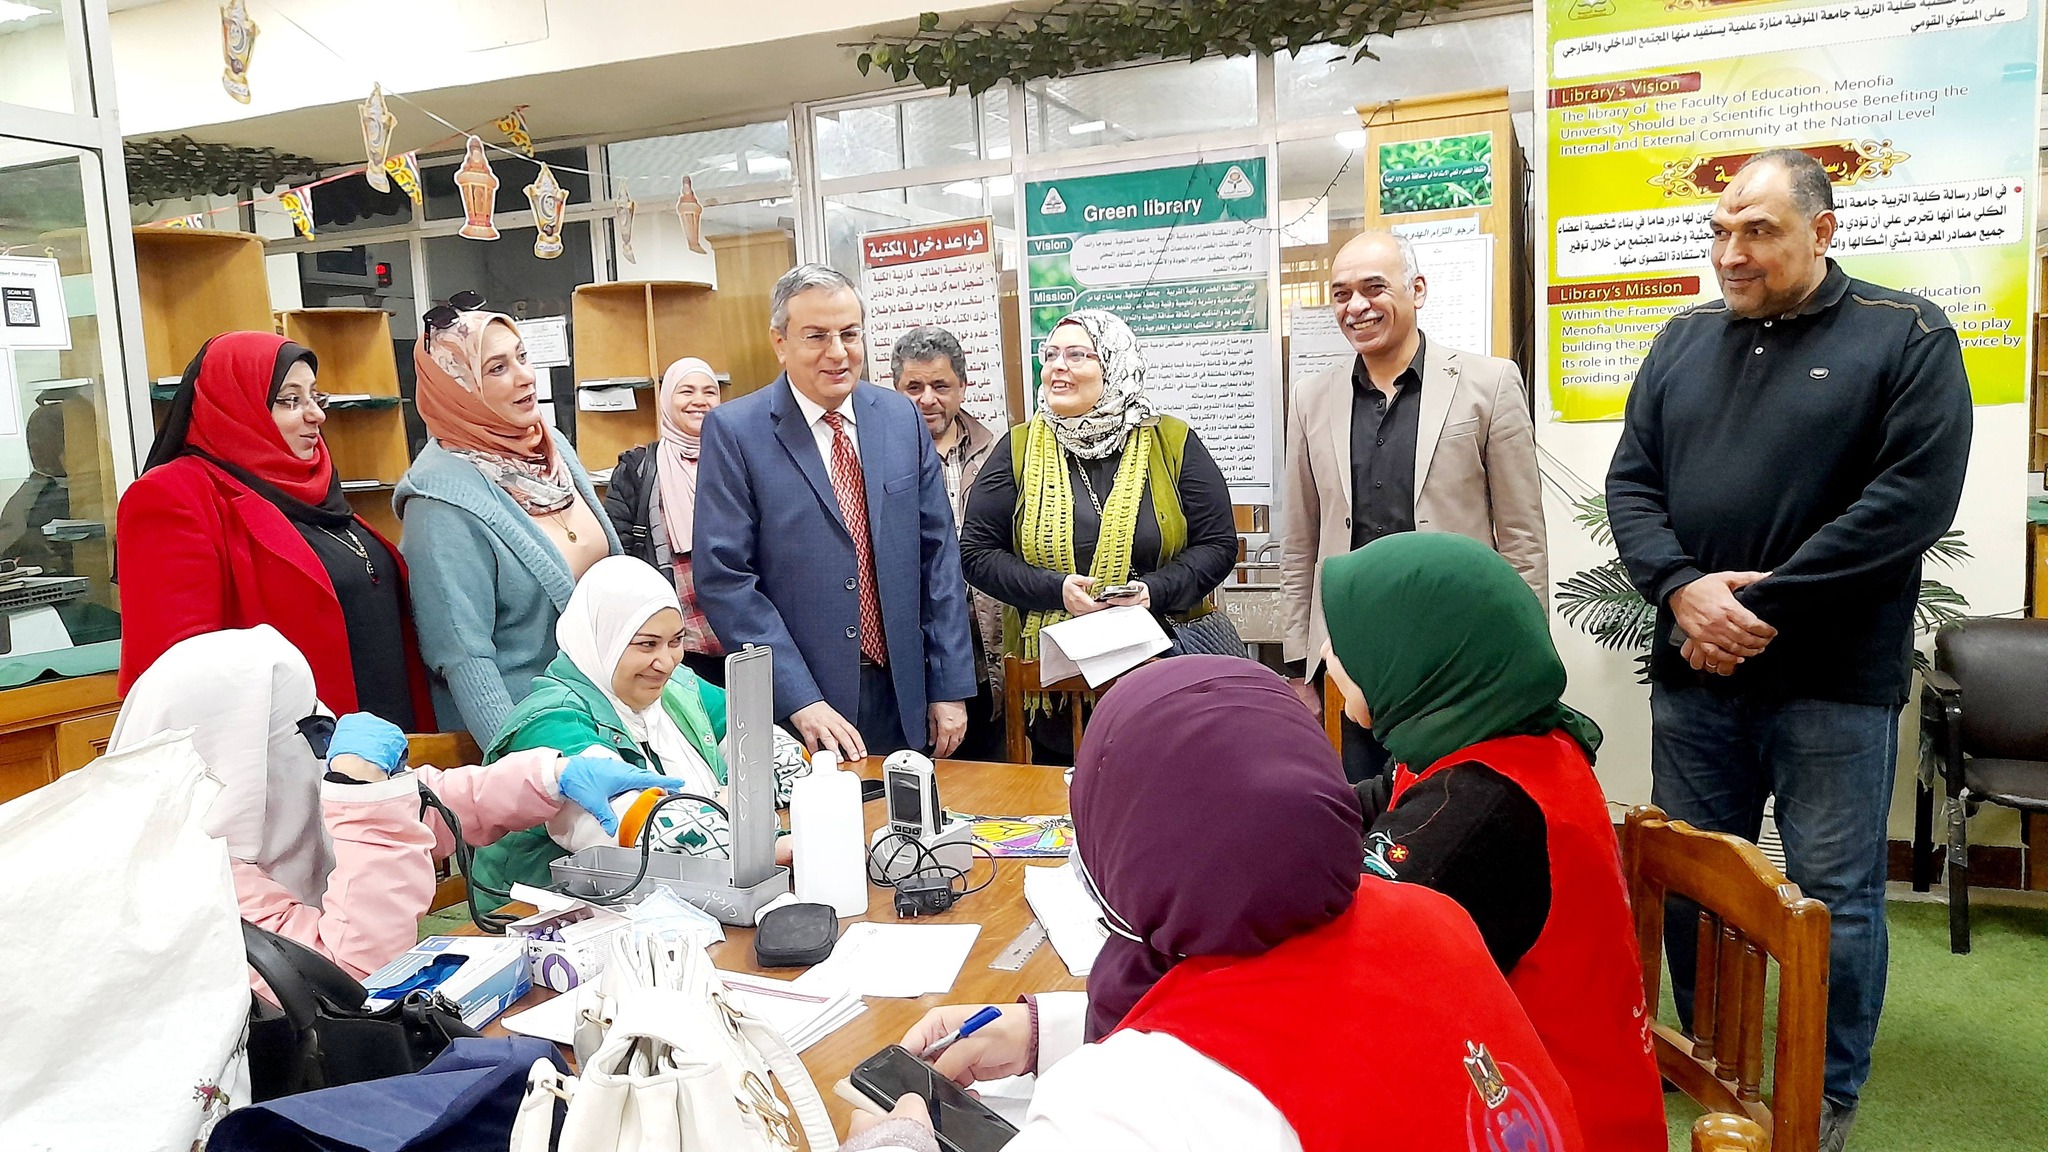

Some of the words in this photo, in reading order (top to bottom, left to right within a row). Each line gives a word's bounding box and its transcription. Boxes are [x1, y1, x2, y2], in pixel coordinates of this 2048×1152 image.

[1821, 8, 1851, 21] جامعة
[1854, 2, 1884, 18] التربية
[1760, 17, 1782, 29] منارة
[1785, 12, 1818, 27] المنوفية
[1911, 14, 1943, 32] القومي
[1693, 25, 1726, 39] يستفيد
[1729, 20, 1756, 35] علمية
[1639, 32, 1669, 49] المجتمع
[1671, 30, 1690, 42] منها
[1562, 41, 1601, 58] والخارجي
[1604, 35, 1636, 53] الداخلي
[1561, 82, 1625, 105] Library's
[1631, 78, 1680, 95] Vision
[1561, 111, 1584, 122] The
[1588, 106, 1629, 122] library
[1633, 103, 1647, 114] of
[1656, 100, 1676, 112] the
[1681, 93, 1728, 110] Faculty
[1733, 91, 1747, 103] of
[1751, 84, 1821, 100] Education
[1834, 74, 1894, 93] Menofia
[1561, 122, 1624, 140] University
[1628, 115, 1674, 133] Should
[1679, 114, 1696, 126] be
[1700, 114, 1708, 125] a
[1712, 106, 1774, 122] Scientific
[1779, 98, 1858, 118] Lighthouse
[1863, 88, 1938, 107] Benefiting
[1944, 84, 1969, 97] the
[1561, 140, 1610, 156] Internal
[1613, 138, 1638, 151] and
[1643, 132, 1696, 148] External
[1699, 123, 1780, 143] Community
[1785, 121, 1799, 133] at
[1803, 117, 1826, 130] the
[1831, 110, 1892, 128] National
[1898, 105, 1935, 121] Level
[1913, 190, 1941, 206] كلية
[1943, 188, 1970, 202] رسالة
[1995, 183, 2007, 200] في
[1849, 197, 1879, 211] جامعة
[1882, 193, 1911, 209] التربية
[1083, 205, 1137, 222] Green
[1143, 198, 1202, 217] library
[1974, 205, 2007, 222] الكلي
[1584, 217, 1616, 233] شخصية
[1618, 218, 1633, 230] بناء
[1635, 216, 1645, 230] في
[1665, 215, 1680, 228] دور
[1682, 212, 1694, 226] لها
[944, 228, 984, 251] قواعد
[1628, 234, 1656, 250] المجتمع
[1658, 231, 1687, 246] وخدمة
[1913, 229, 1945, 247] المعرفة
[1946, 228, 1977, 245] مصادر
[1979, 227, 2005, 242] جميع
[867, 239, 907, 262] المكتبة
[909, 236, 942, 259] دخول
[1034, 240, 1067, 252] Vision
[1569, 241, 1588, 254] توفير
[1590, 238, 1612, 252] خلال
[1614, 239, 1626, 250] من
[1619, 254, 1636, 268] منها
[1671, 248, 1710, 261] الاستفادة
[1033, 291, 1073, 303] Mission
[1560, 284, 1622, 302] Library's
[1625, 280, 1683, 297] Mission
[1562, 309, 1601, 321] Within
[1604, 307, 1624, 318] the
[1942, 302, 1970, 313] role
[1974, 301, 1987, 312] in
[1562, 323, 1611, 337] Menofia
[1963, 320, 1977, 330] to
[1981, 317, 2012, 332] play
[1562, 339, 1612, 353] building
[1615, 338, 1636, 350] the
[2003, 334, 2021, 347] by
[1562, 358, 1575, 369] its
[1578, 356, 1602, 368] role
[1604, 355, 1616, 366] in
[1619, 354, 1640, 366] the
[1562, 372, 1620, 386] providing
[1623, 370, 1637, 382] all
